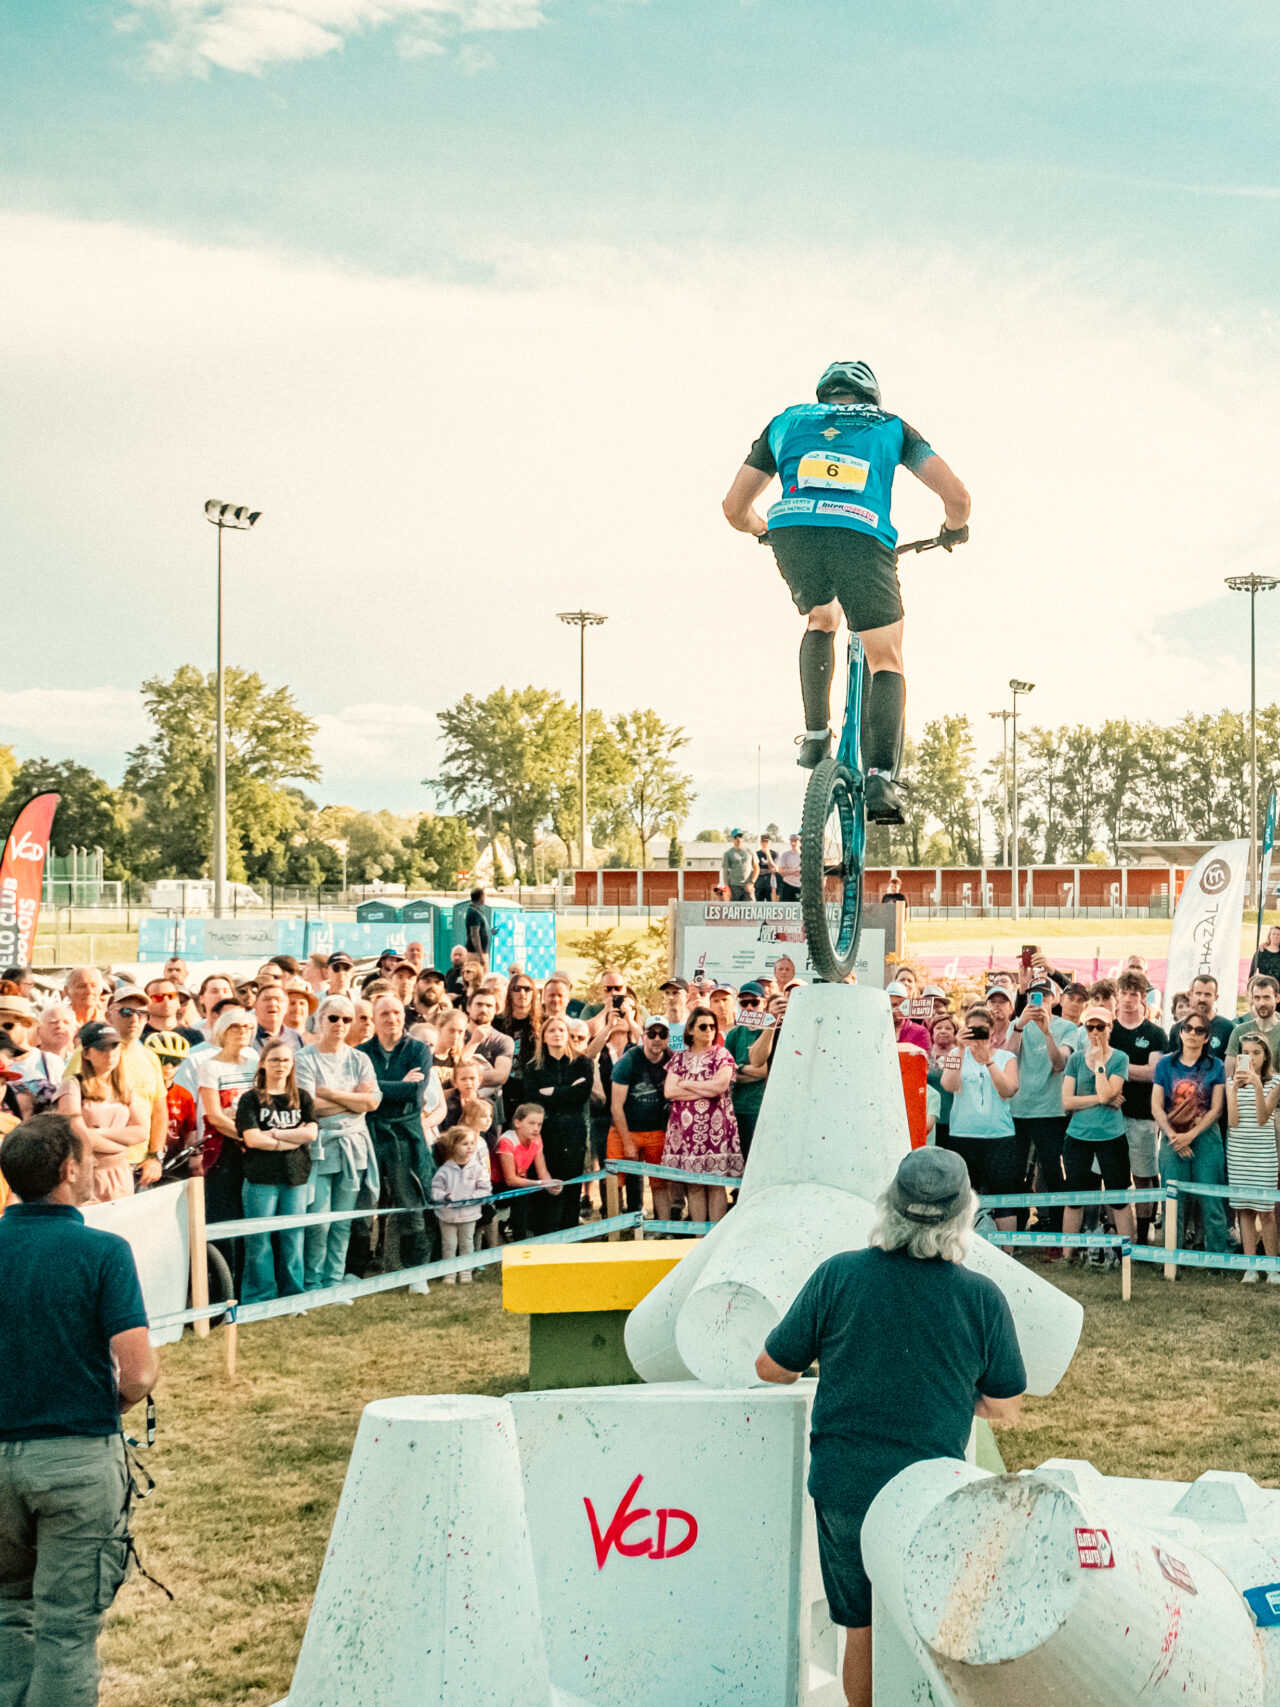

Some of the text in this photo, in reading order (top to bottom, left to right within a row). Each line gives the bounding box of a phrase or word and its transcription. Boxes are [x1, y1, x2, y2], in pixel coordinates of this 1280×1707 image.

[826, 463, 840, 478] 6
[10, 831, 44, 862] VCD
[1, 877, 18, 927] CLUB
[962, 882, 972, 908] 5
[1063, 882, 1074, 908] 7
[1110, 882, 1120, 908] 8
[704, 906, 720, 920] LES
[722, 906, 784, 920] PARTENAIRES
[785, 906, 798, 921] DE
[1193, 903, 1219, 976] CHAZAL
[260, 1107, 302, 1125] PARIS
[583, 1473, 699, 1571] VCD
